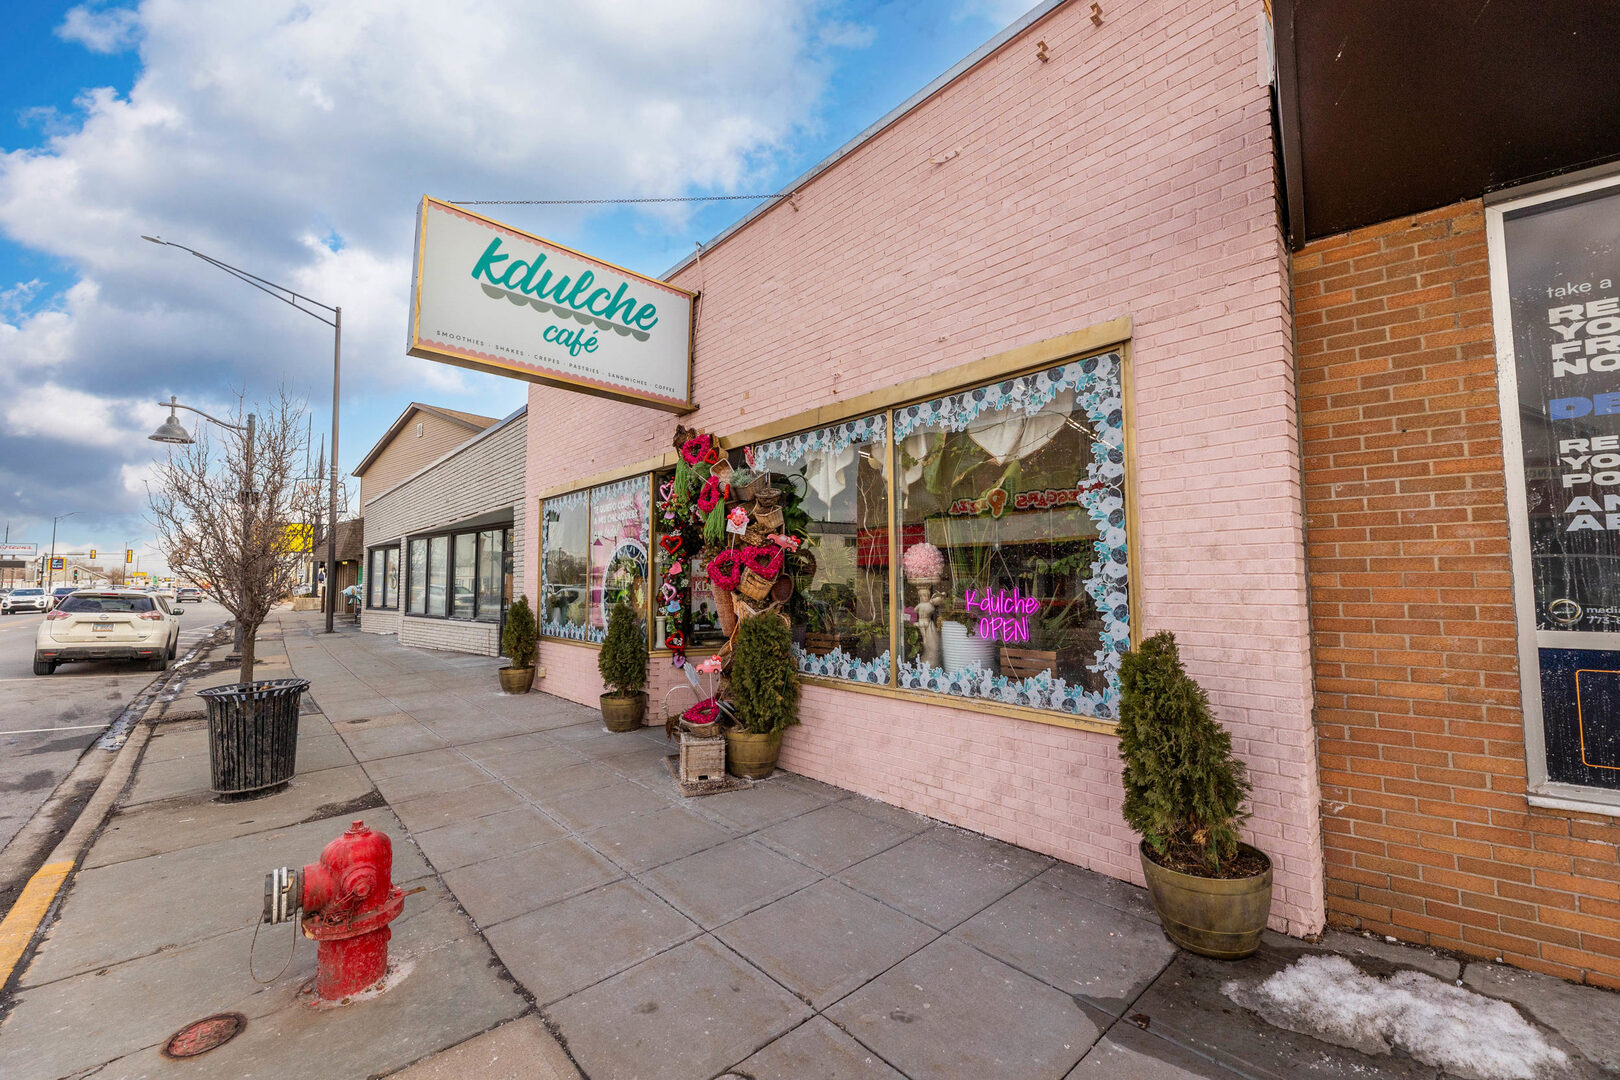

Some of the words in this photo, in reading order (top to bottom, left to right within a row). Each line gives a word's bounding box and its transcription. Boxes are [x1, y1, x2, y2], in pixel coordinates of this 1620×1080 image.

[1546, 282, 1592, 298] take
[1600, 278, 1612, 289] a
[542, 325, 600, 357] café
[436, 330, 485, 347] SMOOTHIES
[495, 344, 524, 357] SHAKES
[534, 354, 560, 365] CREPES
[569, 362, 600, 375] PASTRIES
[608, 372, 648, 386] SANDWICHES
[654, 384, 676, 393] COFFEE
[965, 587, 1040, 616] Kdulche
[980, 616, 1030, 642] OPEN
